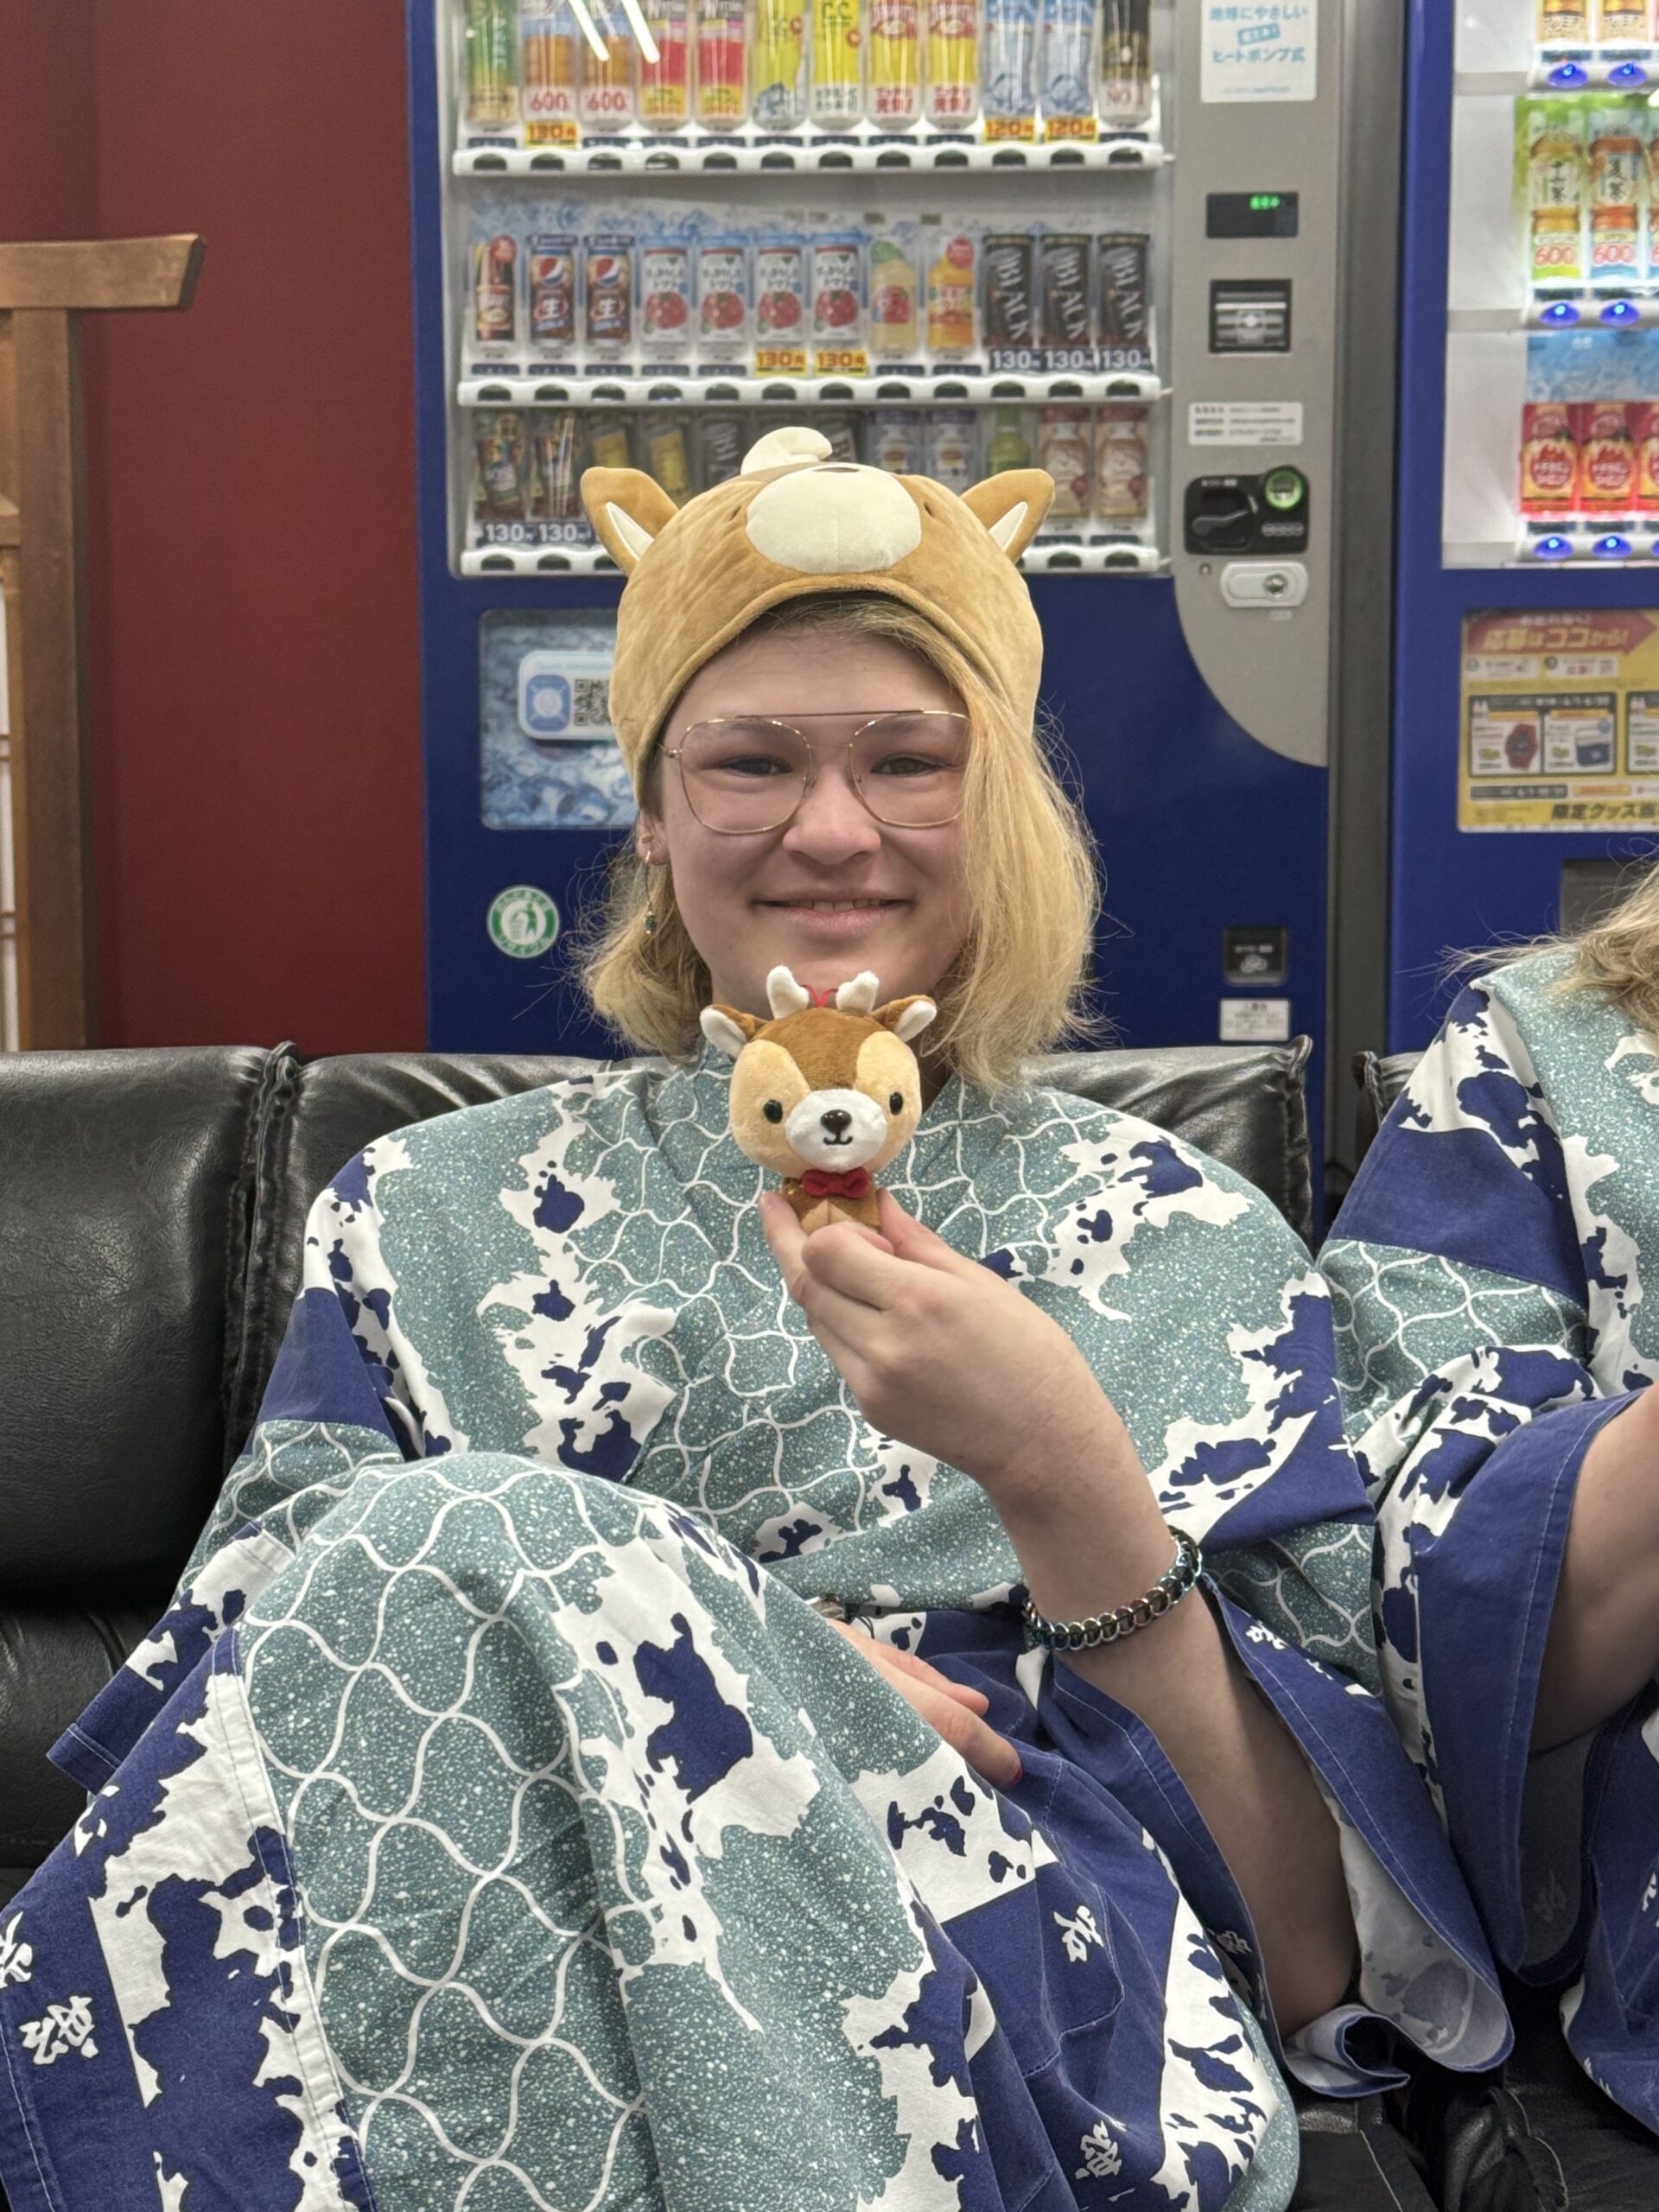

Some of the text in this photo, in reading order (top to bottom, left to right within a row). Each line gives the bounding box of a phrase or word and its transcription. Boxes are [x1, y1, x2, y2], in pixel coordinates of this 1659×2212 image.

[1211, 47, 1306, 64] ヒートポンプ式
